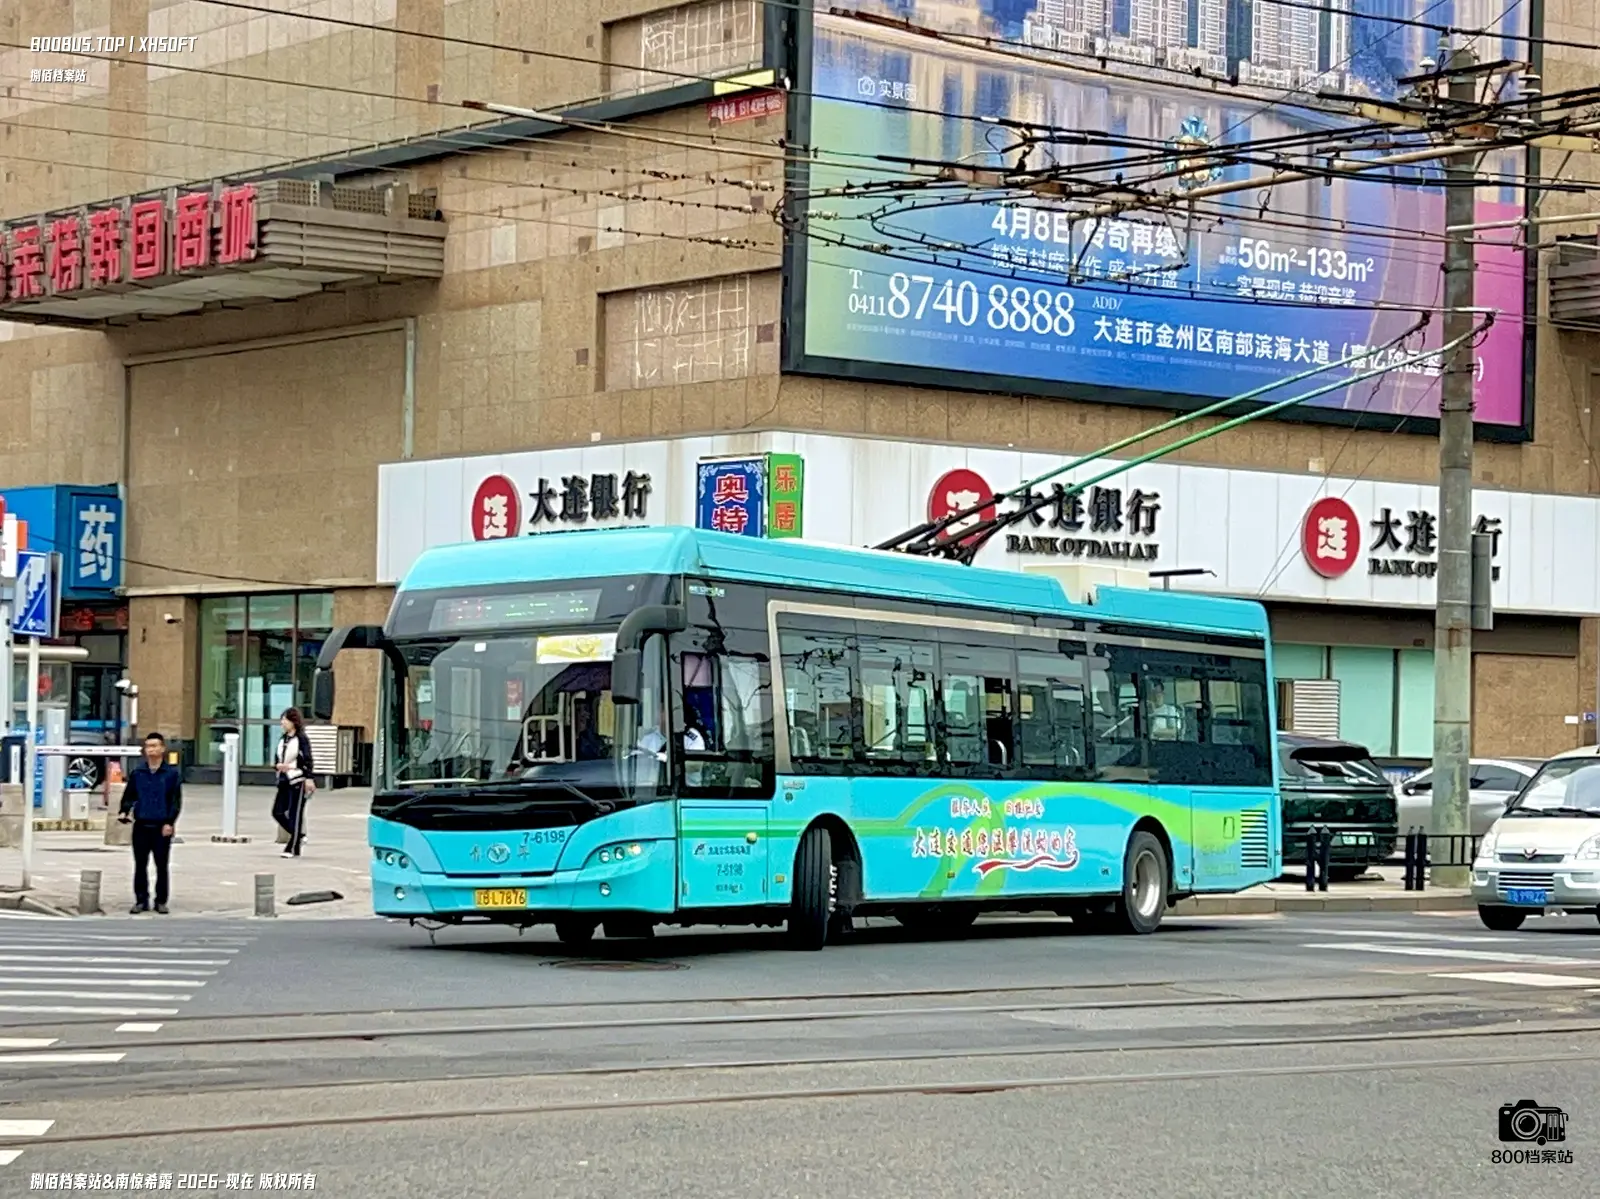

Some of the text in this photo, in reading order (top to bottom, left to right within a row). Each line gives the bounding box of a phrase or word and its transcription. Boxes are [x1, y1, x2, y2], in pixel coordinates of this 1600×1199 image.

[1082, 217, 1179, 259] 传奇再续
[848, 272, 1075, 337] 0411 8740 8888
[528, 470, 652, 524] 大连银行
[712, 473, 749, 534] 奥特
[1005, 482, 1162, 536] 大连银行
[79, 504, 116, 581] 药
[1006, 534, 1060, 556] BANK
[1086, 540, 1160, 561] DALIAN
[1370, 508, 1502, 557] 大连行
[1368, 557, 1415, 575] BANK
[522, 830, 565, 844] 7-6198
